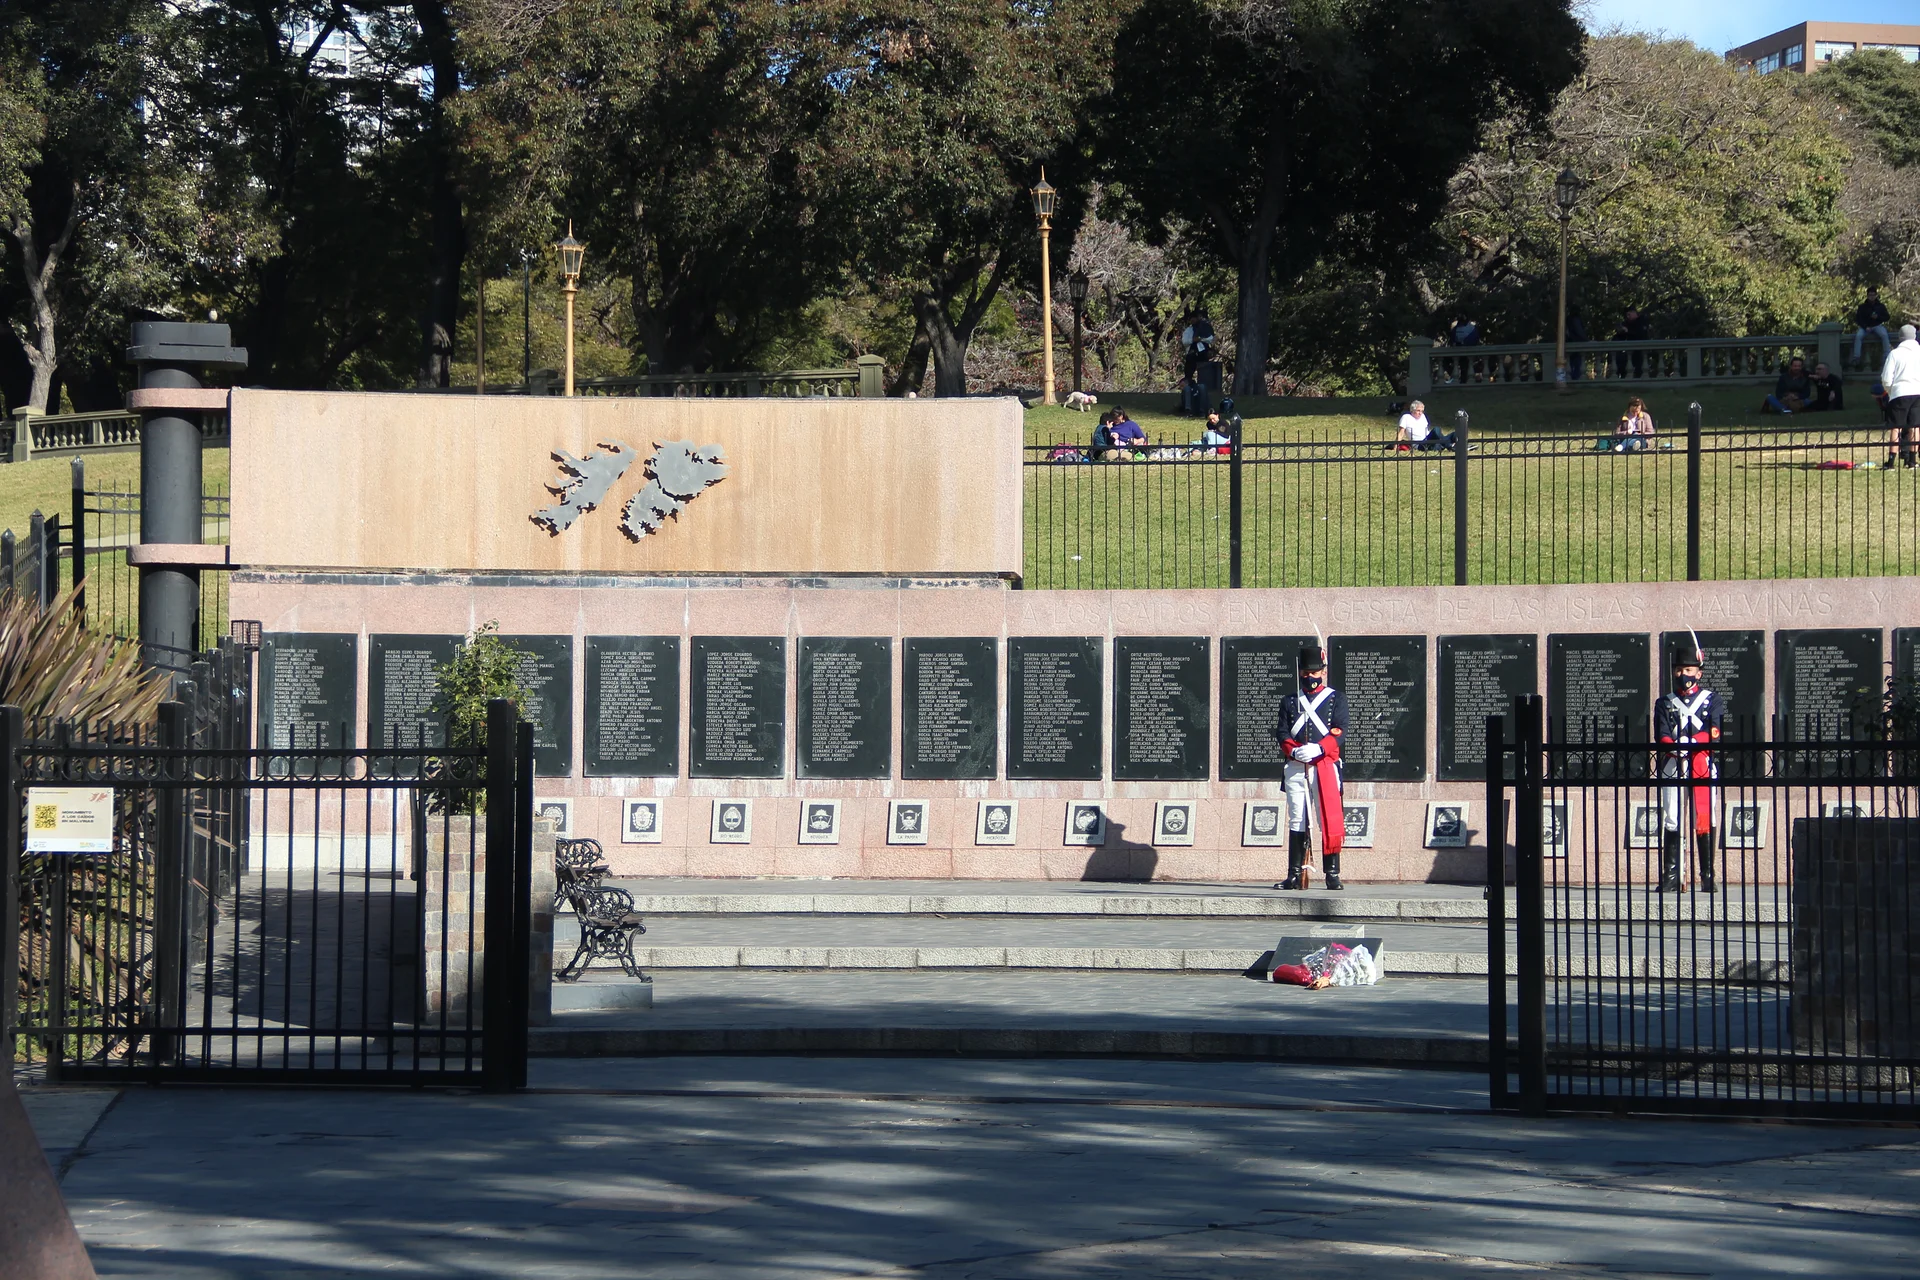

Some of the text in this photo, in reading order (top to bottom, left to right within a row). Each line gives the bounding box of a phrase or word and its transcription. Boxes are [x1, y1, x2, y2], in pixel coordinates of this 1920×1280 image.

[1022, 602, 1038, 625] A
[1052, 602, 1100, 625] LOS
[1228, 602, 1262, 624] EN
[1282, 600, 1312, 624] LA
[1332, 599, 1418, 623] GESTA
[1438, 598, 1471, 621] DE
[1492, 598, 1541, 621] LAS
[1564, 596, 1644, 620] ISLAS
[1681, 591, 1833, 618] MALVINAS
[1870, 591, 1888, 614] Y
